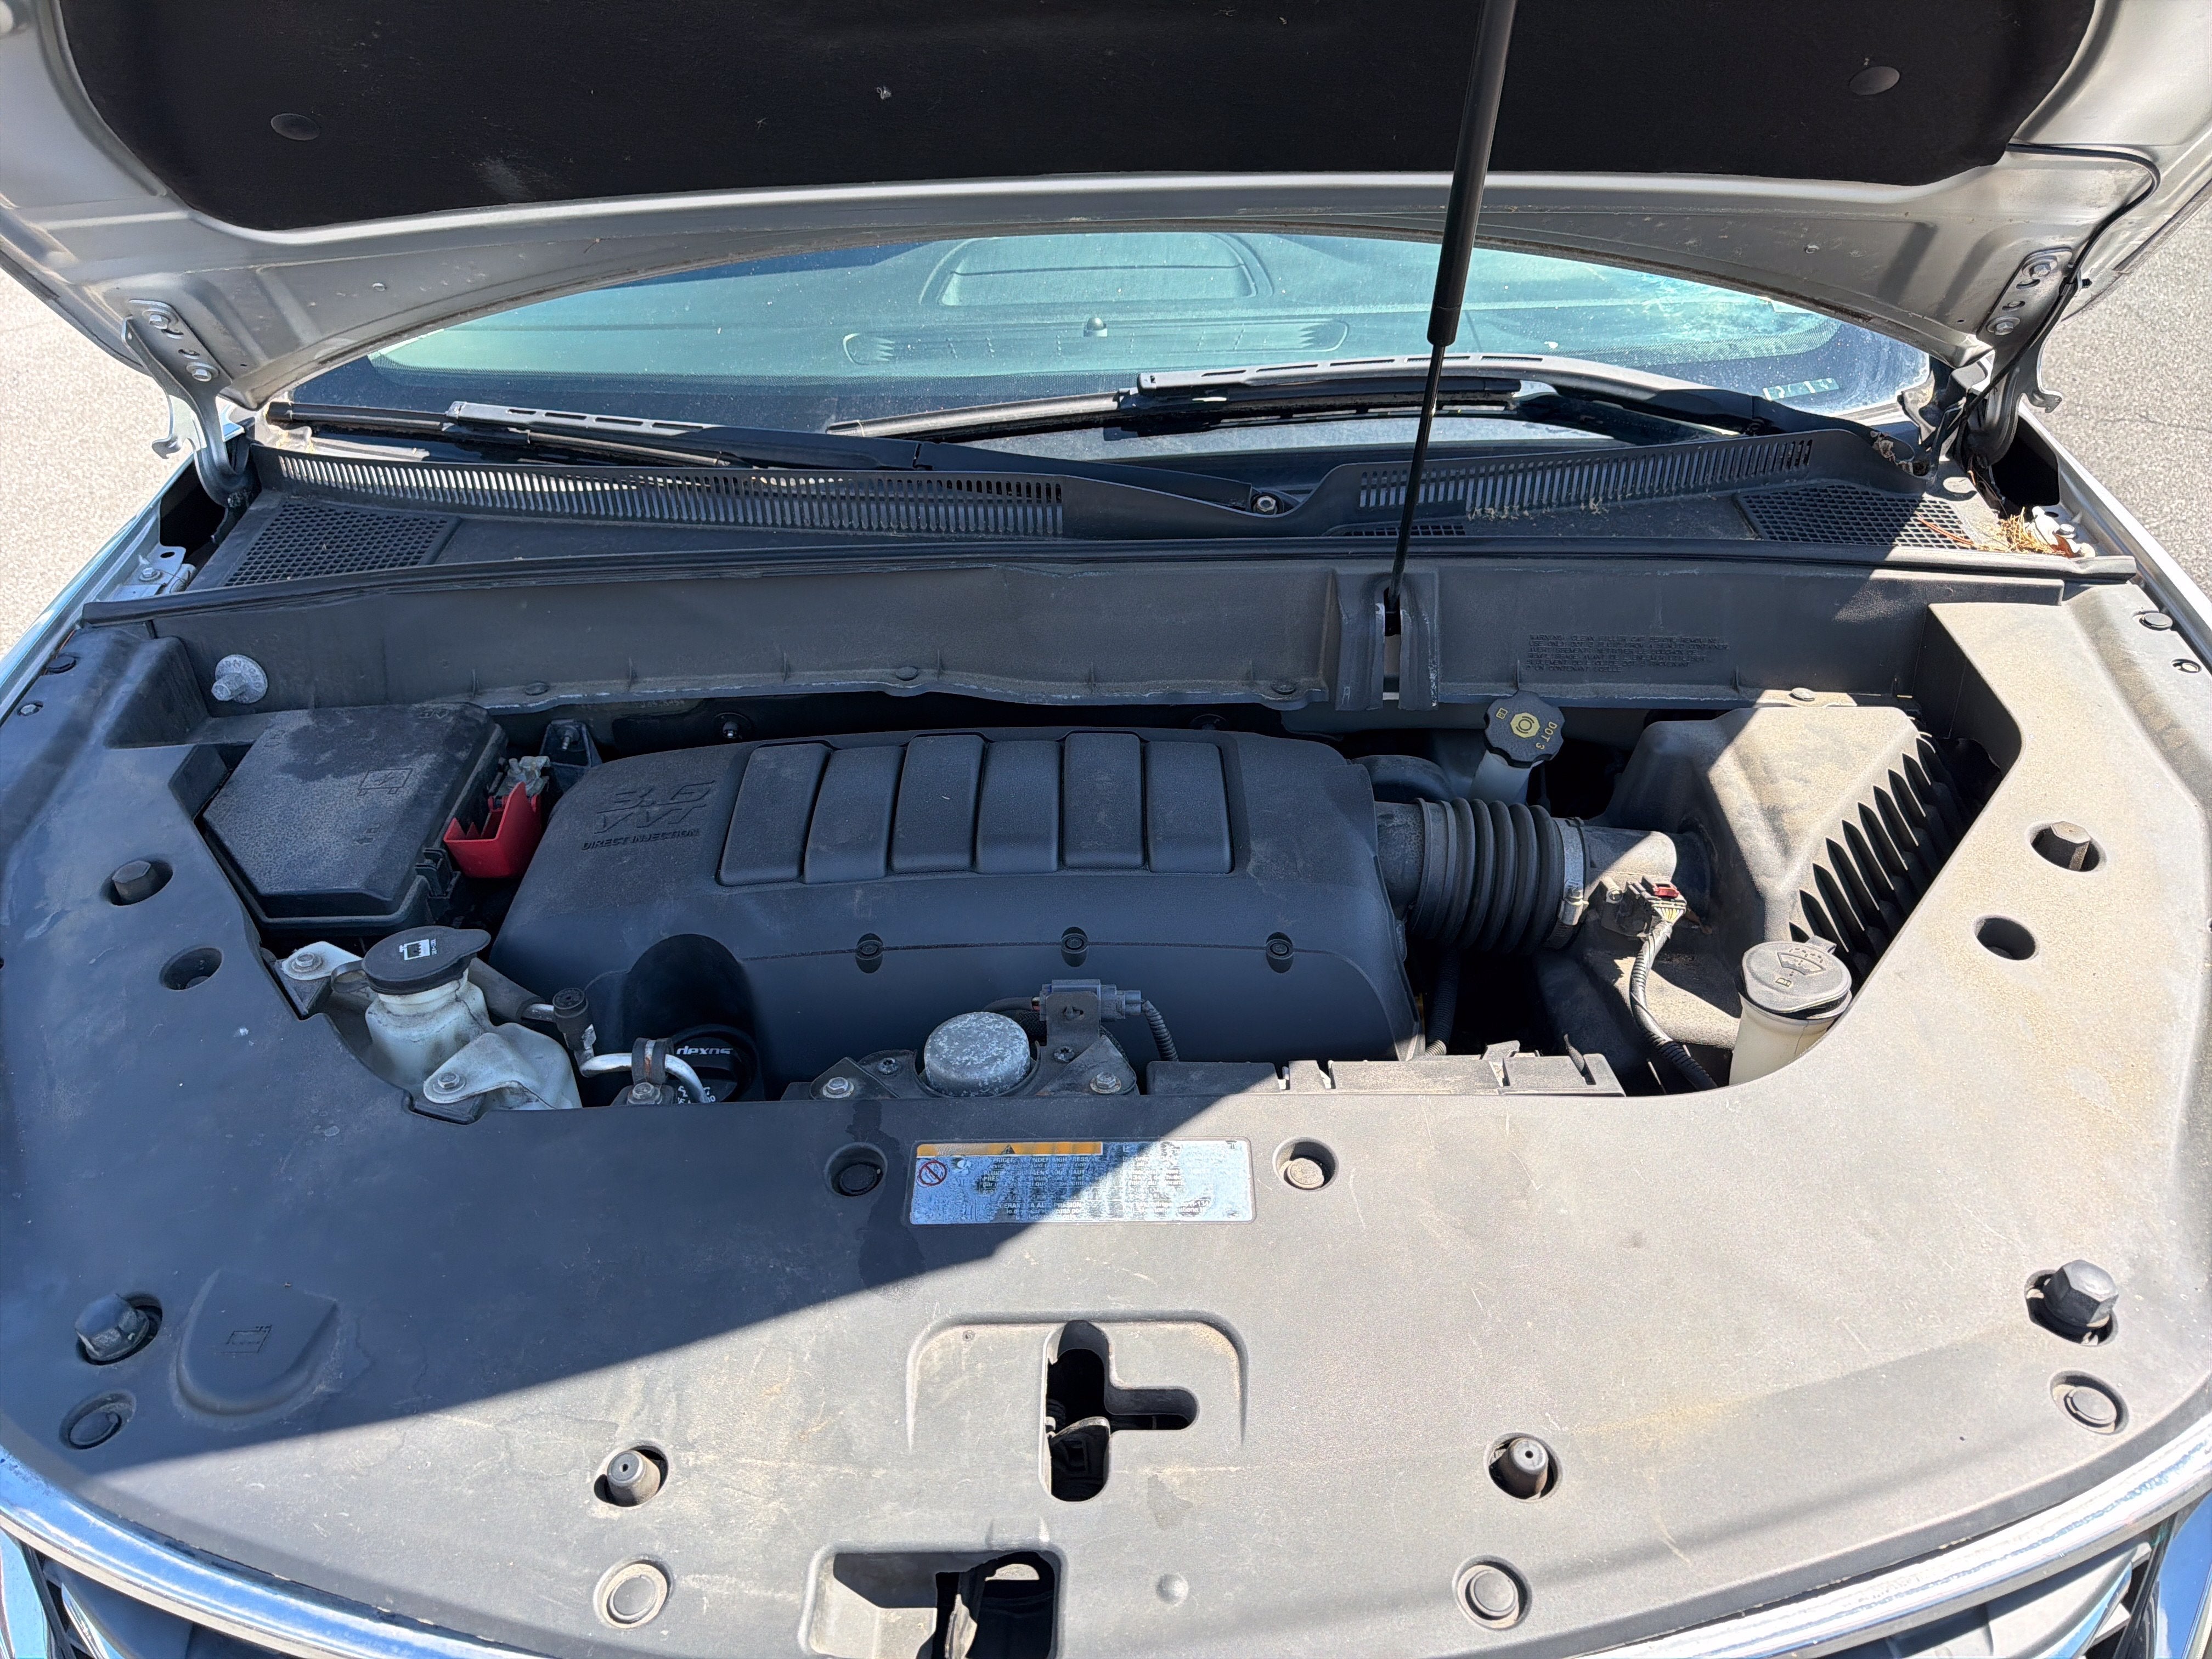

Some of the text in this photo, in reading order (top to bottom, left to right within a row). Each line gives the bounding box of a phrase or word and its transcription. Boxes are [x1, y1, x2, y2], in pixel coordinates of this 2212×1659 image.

[1541, 721, 1558, 742] DOT
[581, 828, 699, 851] DIRECT INJECTION
